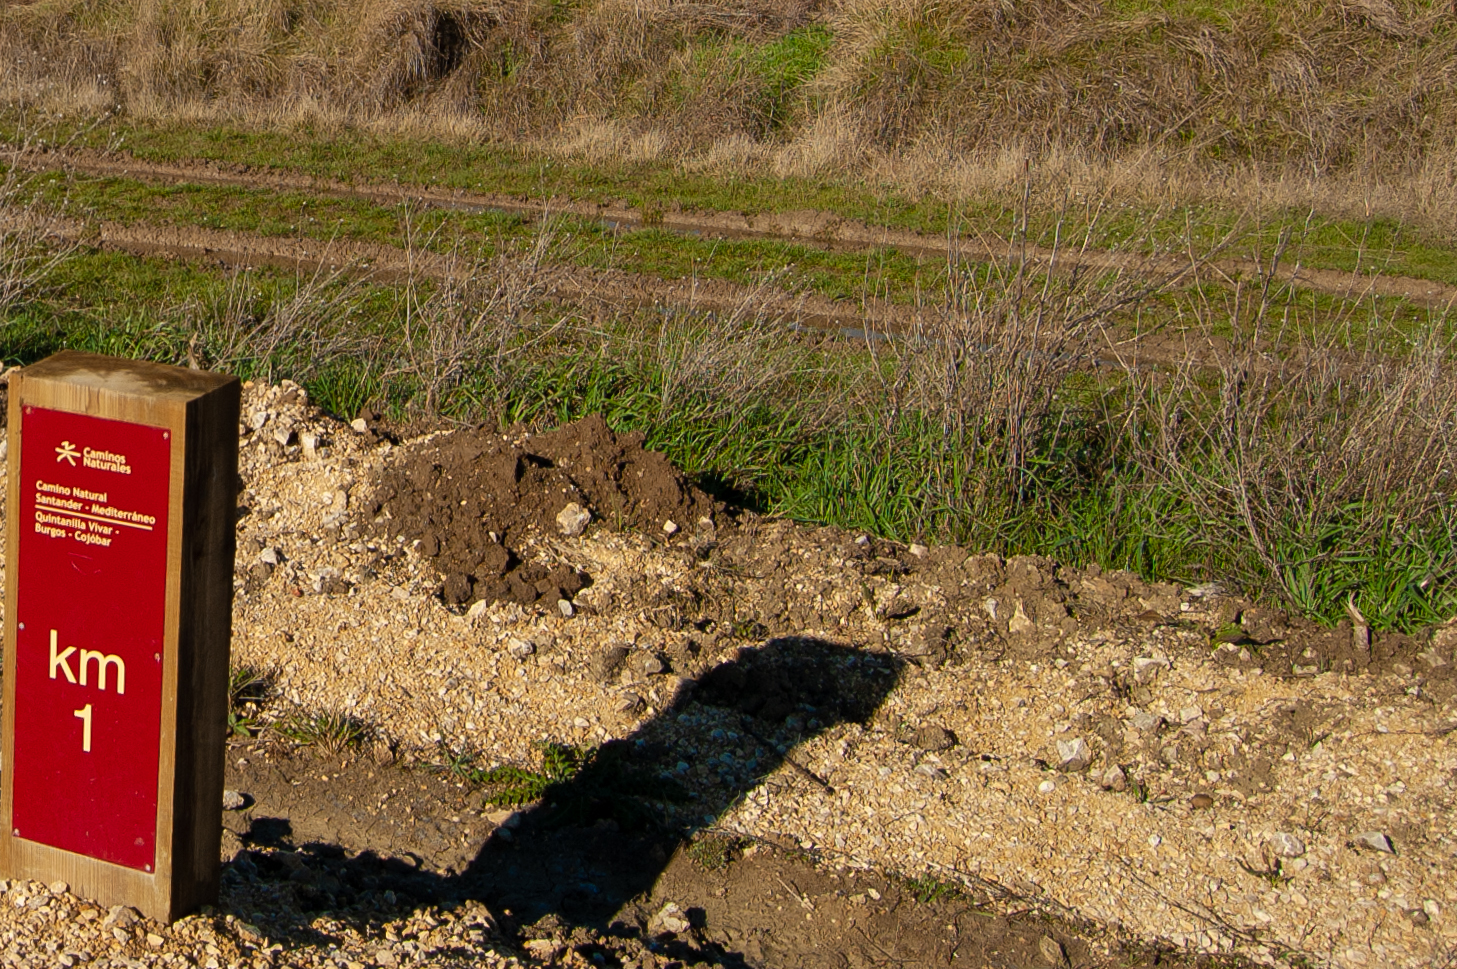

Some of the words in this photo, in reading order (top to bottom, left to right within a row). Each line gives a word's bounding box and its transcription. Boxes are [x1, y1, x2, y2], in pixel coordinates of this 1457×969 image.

[83, 447, 126, 464] Caminos
[83, 458, 131, 474] Naturales
[36, 480, 71, 496] Camino
[73, 488, 107, 503] Natural
[35, 493, 83, 511] Santander
[91, 504, 156, 525] Mediterráneo
[35, 511, 86, 530] Quintanilla
[88, 521, 113, 535] Vivar
[35, 523, 66, 538] Burgos
[74, 531, 112, 547] Cojóbar
[49, 629, 125, 694] km
[74, 704, 92, 752] 1
